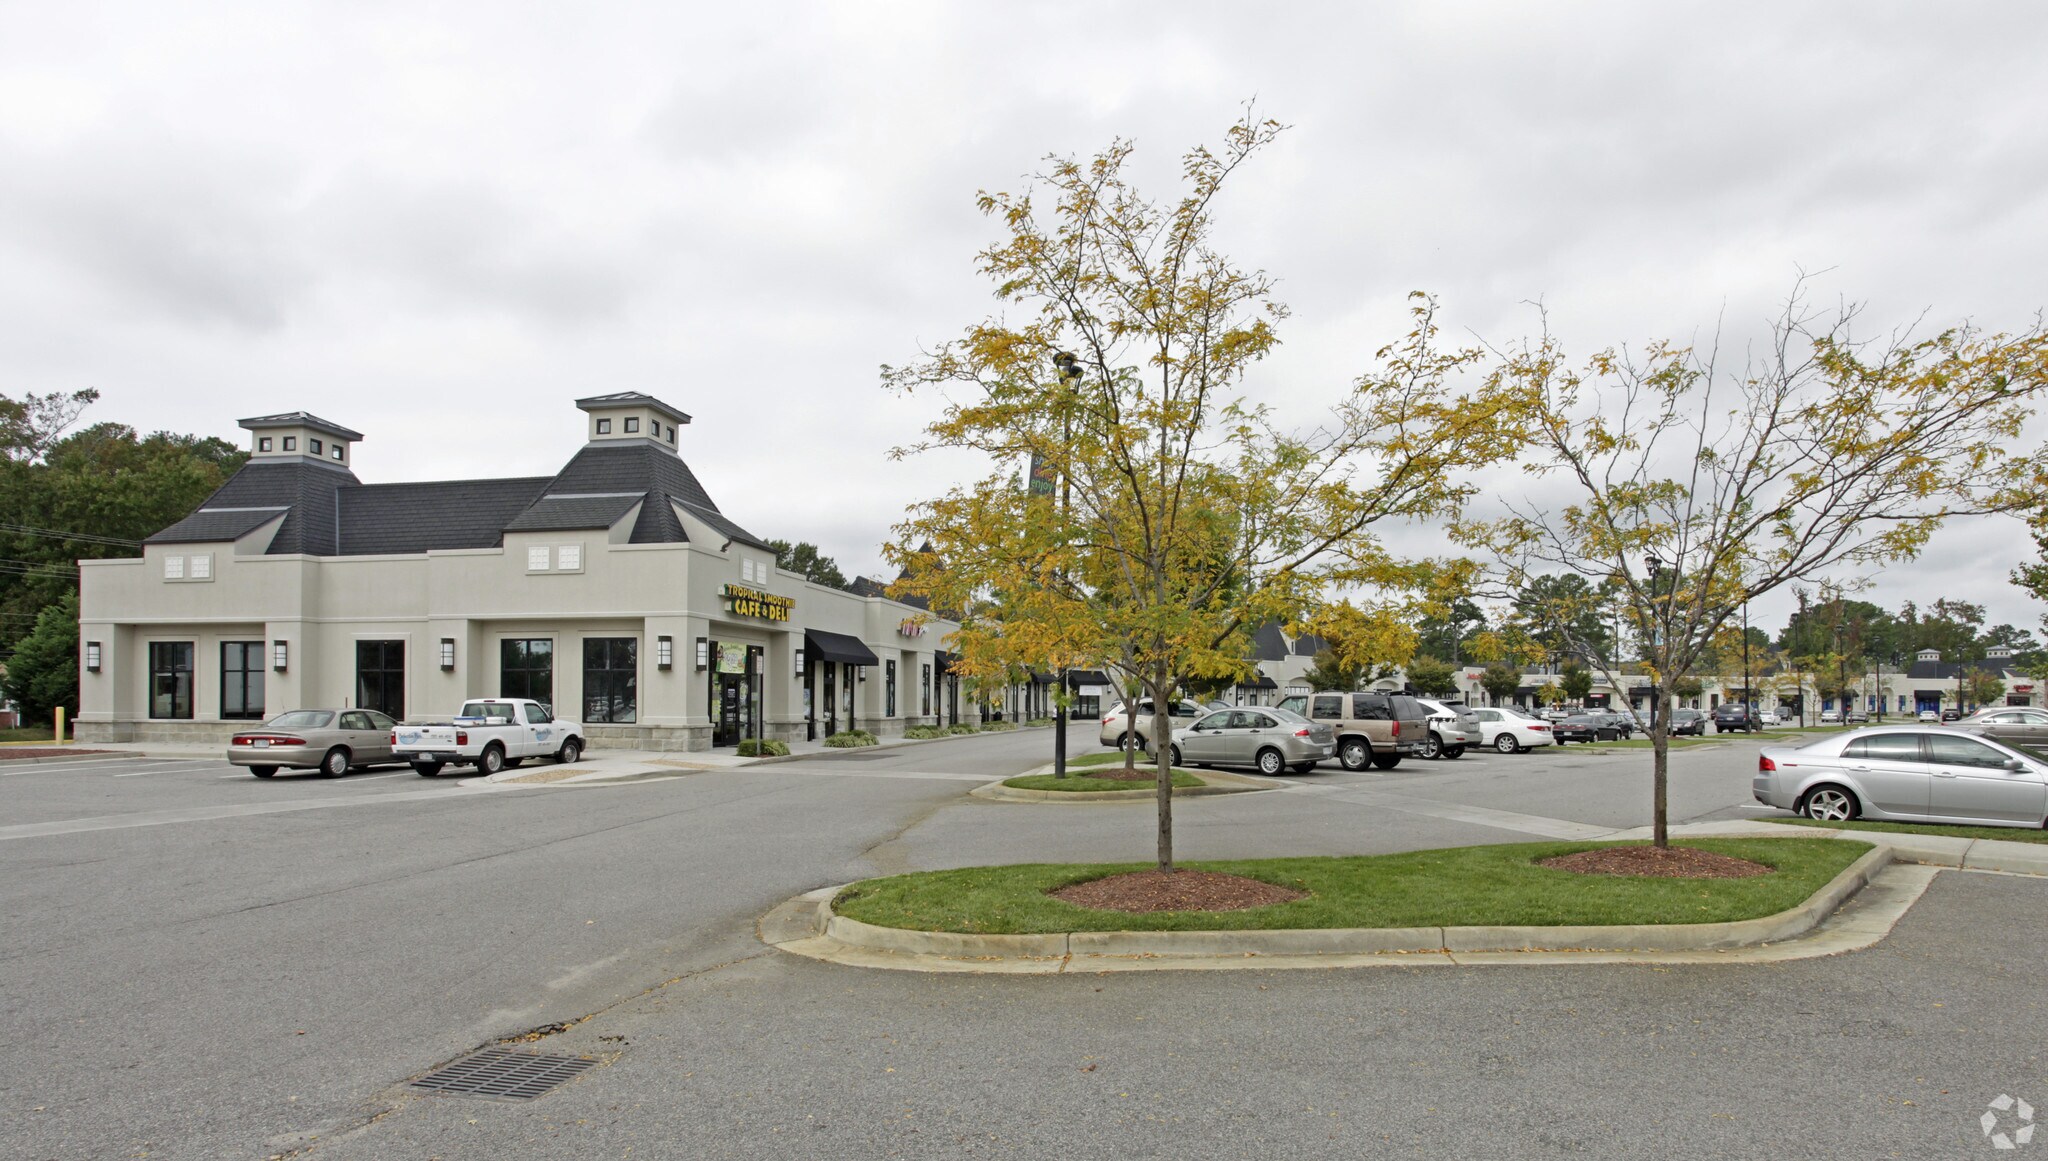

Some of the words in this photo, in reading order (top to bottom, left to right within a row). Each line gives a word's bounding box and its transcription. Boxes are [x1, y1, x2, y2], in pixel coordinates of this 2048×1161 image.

[1031, 479, 1053, 492] enjoy
[728, 584, 762, 601] TROPICAL
[764, 593, 795, 609] SMOOTHIE
[735, 599, 760, 617] CAFE
[762, 604, 768, 616] &
[769, 605, 789, 622] DELI
